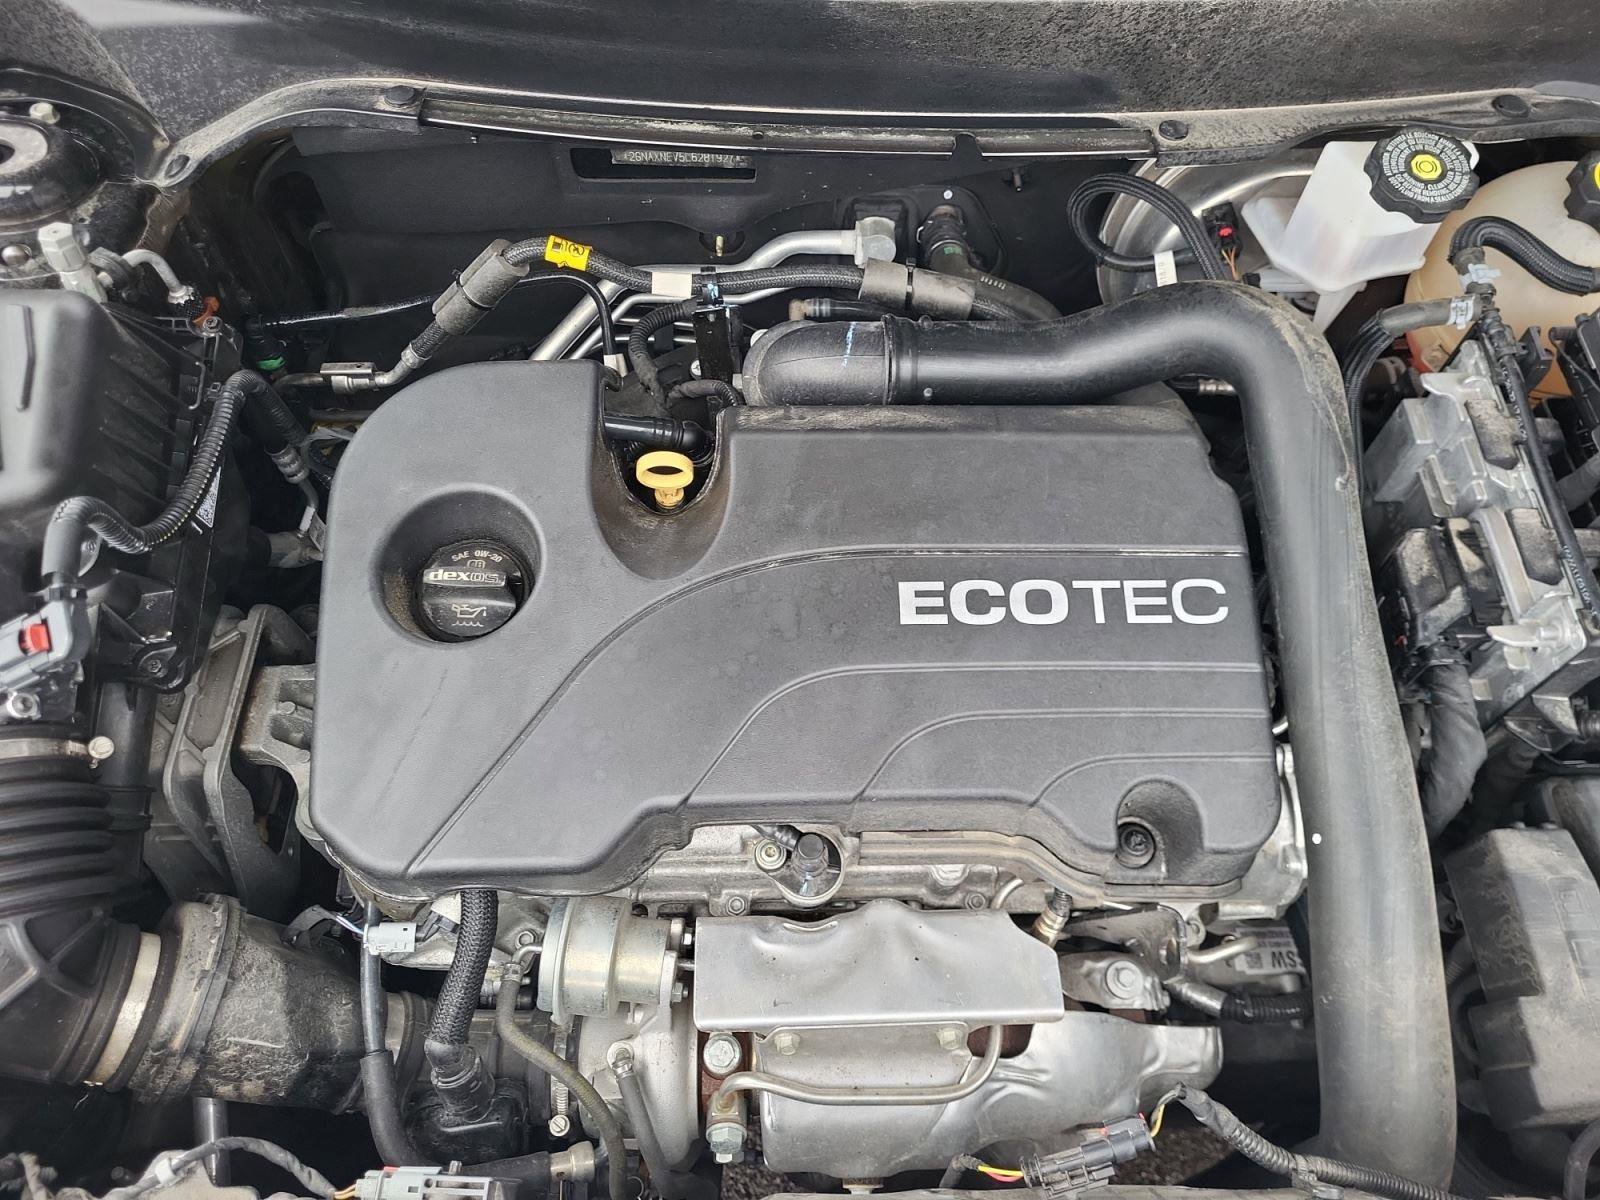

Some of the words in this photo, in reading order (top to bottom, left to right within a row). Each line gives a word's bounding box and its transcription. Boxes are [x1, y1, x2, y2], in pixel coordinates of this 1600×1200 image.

[1414, 131, 1439, 140] BOUCHON
[1439, 138, 1456, 150] AVANT
[1453, 148, 1461, 156] LA
[1395, 173, 1405, 182] CAP
[1399, 185, 1414, 198] FLUID
[1413, 195, 1430, 203] FROM
[451, 551, 470, 562] SAE
[474, 549, 503, 563] 0W-20
[898, 578, 1229, 625] ECOTEC
